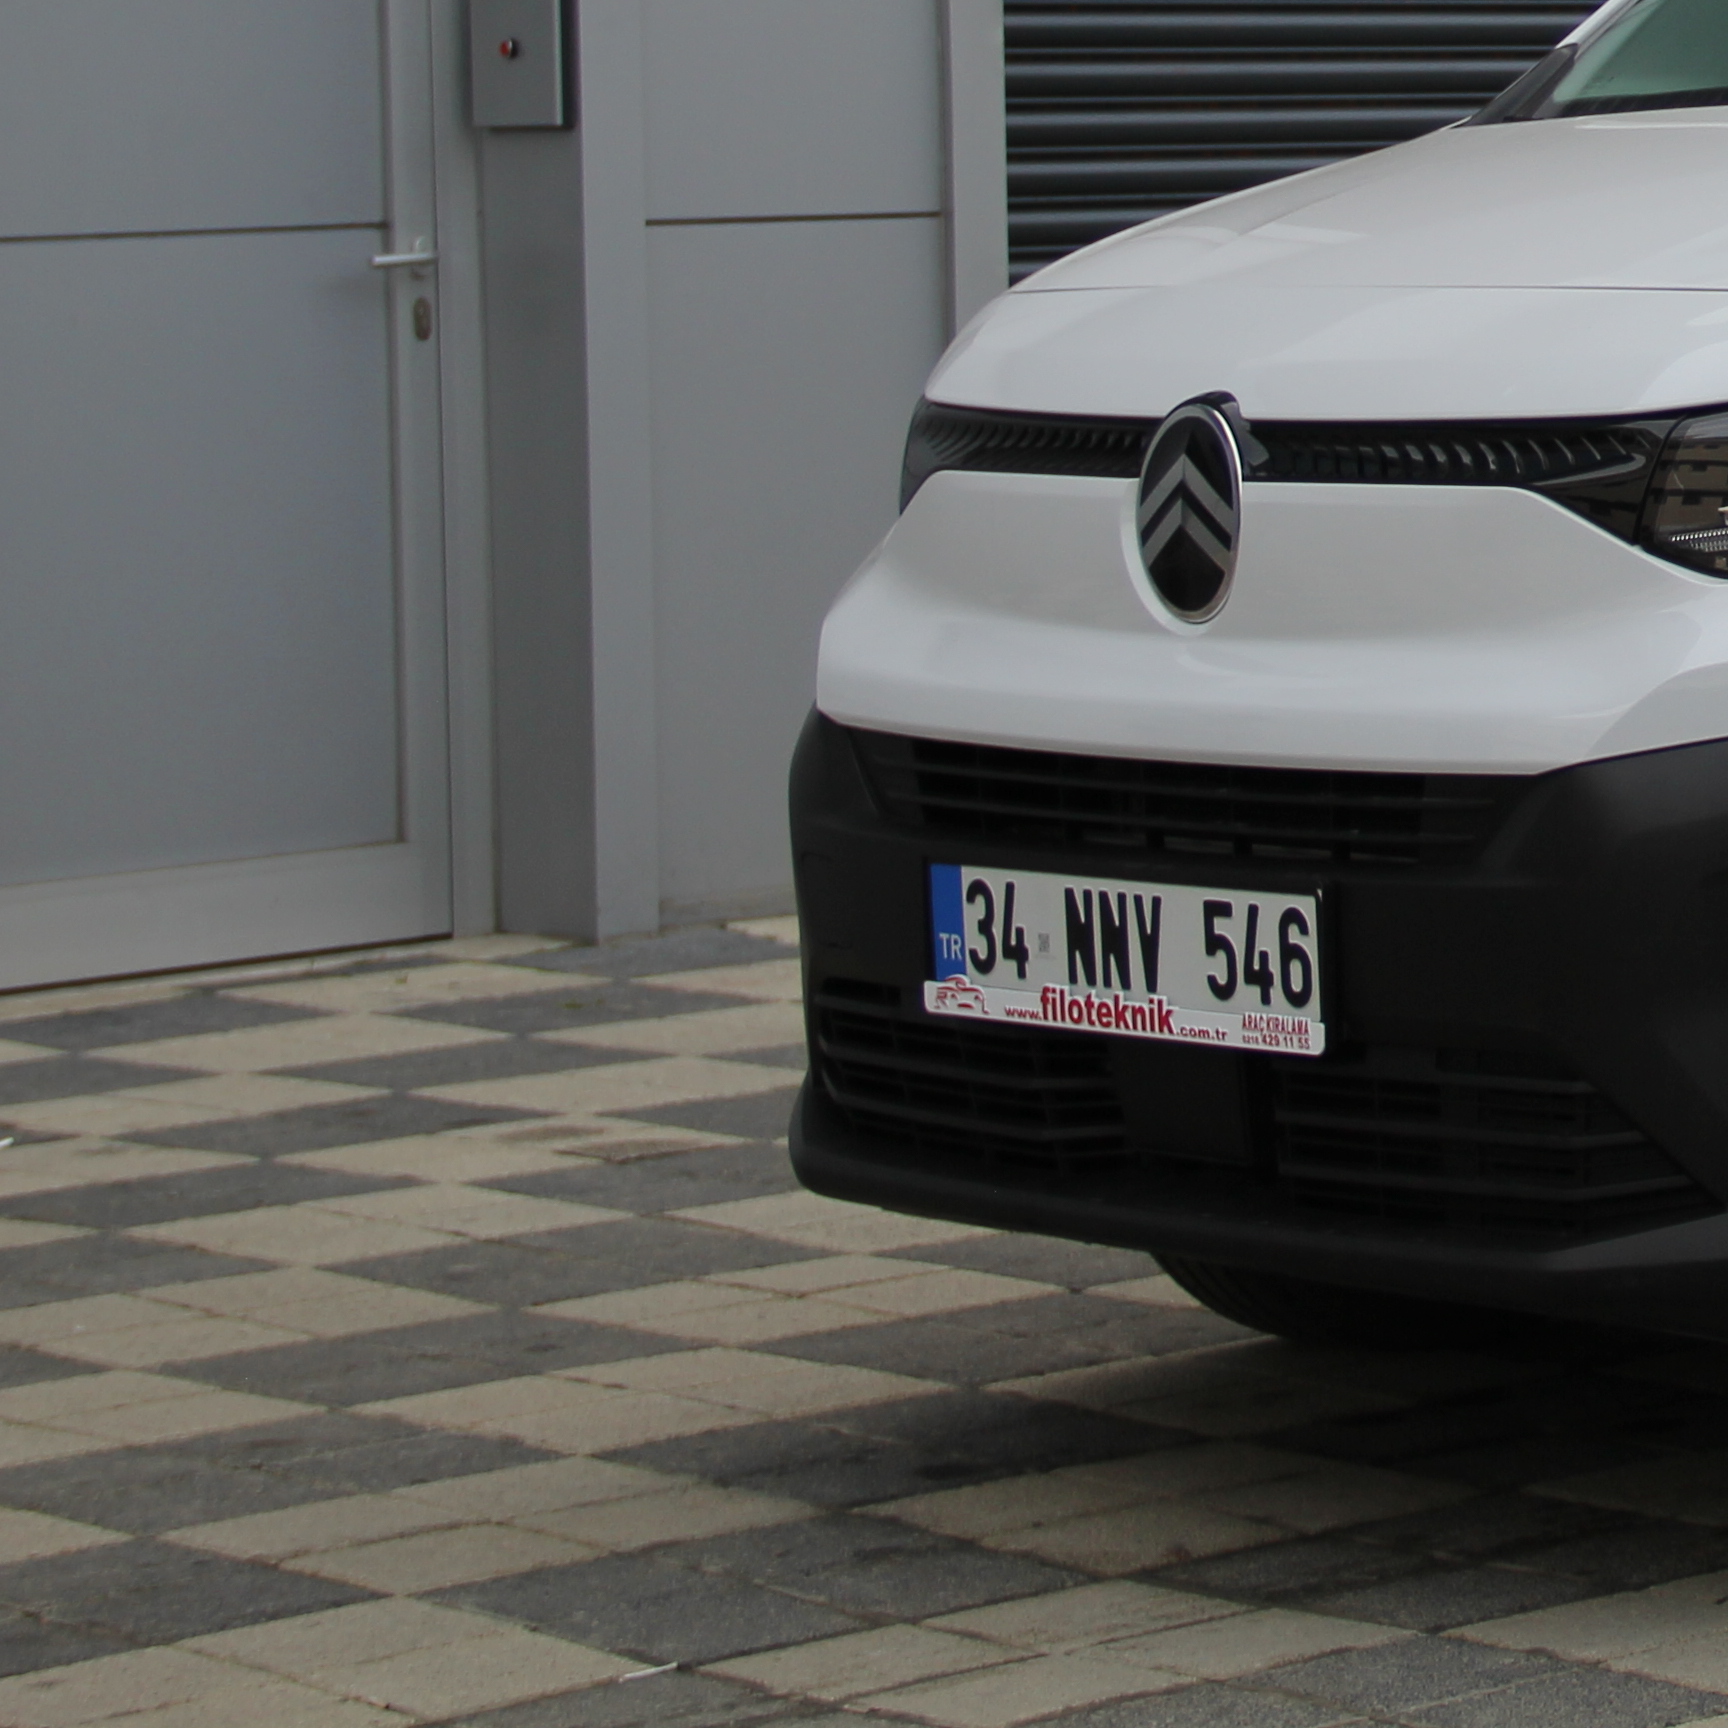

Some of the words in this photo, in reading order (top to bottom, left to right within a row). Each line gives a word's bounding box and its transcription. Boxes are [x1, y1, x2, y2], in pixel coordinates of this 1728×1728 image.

[939, 932, 963, 962] TR
[966, 878, 1029, 980] 34
[1064, 886, 1163, 994] NNV
[1203, 898, 1314, 1009] 546
[1004, 985, 1228, 1041] www.filoteknik.com.tr
[1261, 1033, 1280, 1048] 429
[1283, 1036, 1295, 1050] 11
[1298, 1037, 1310, 1050] 55
